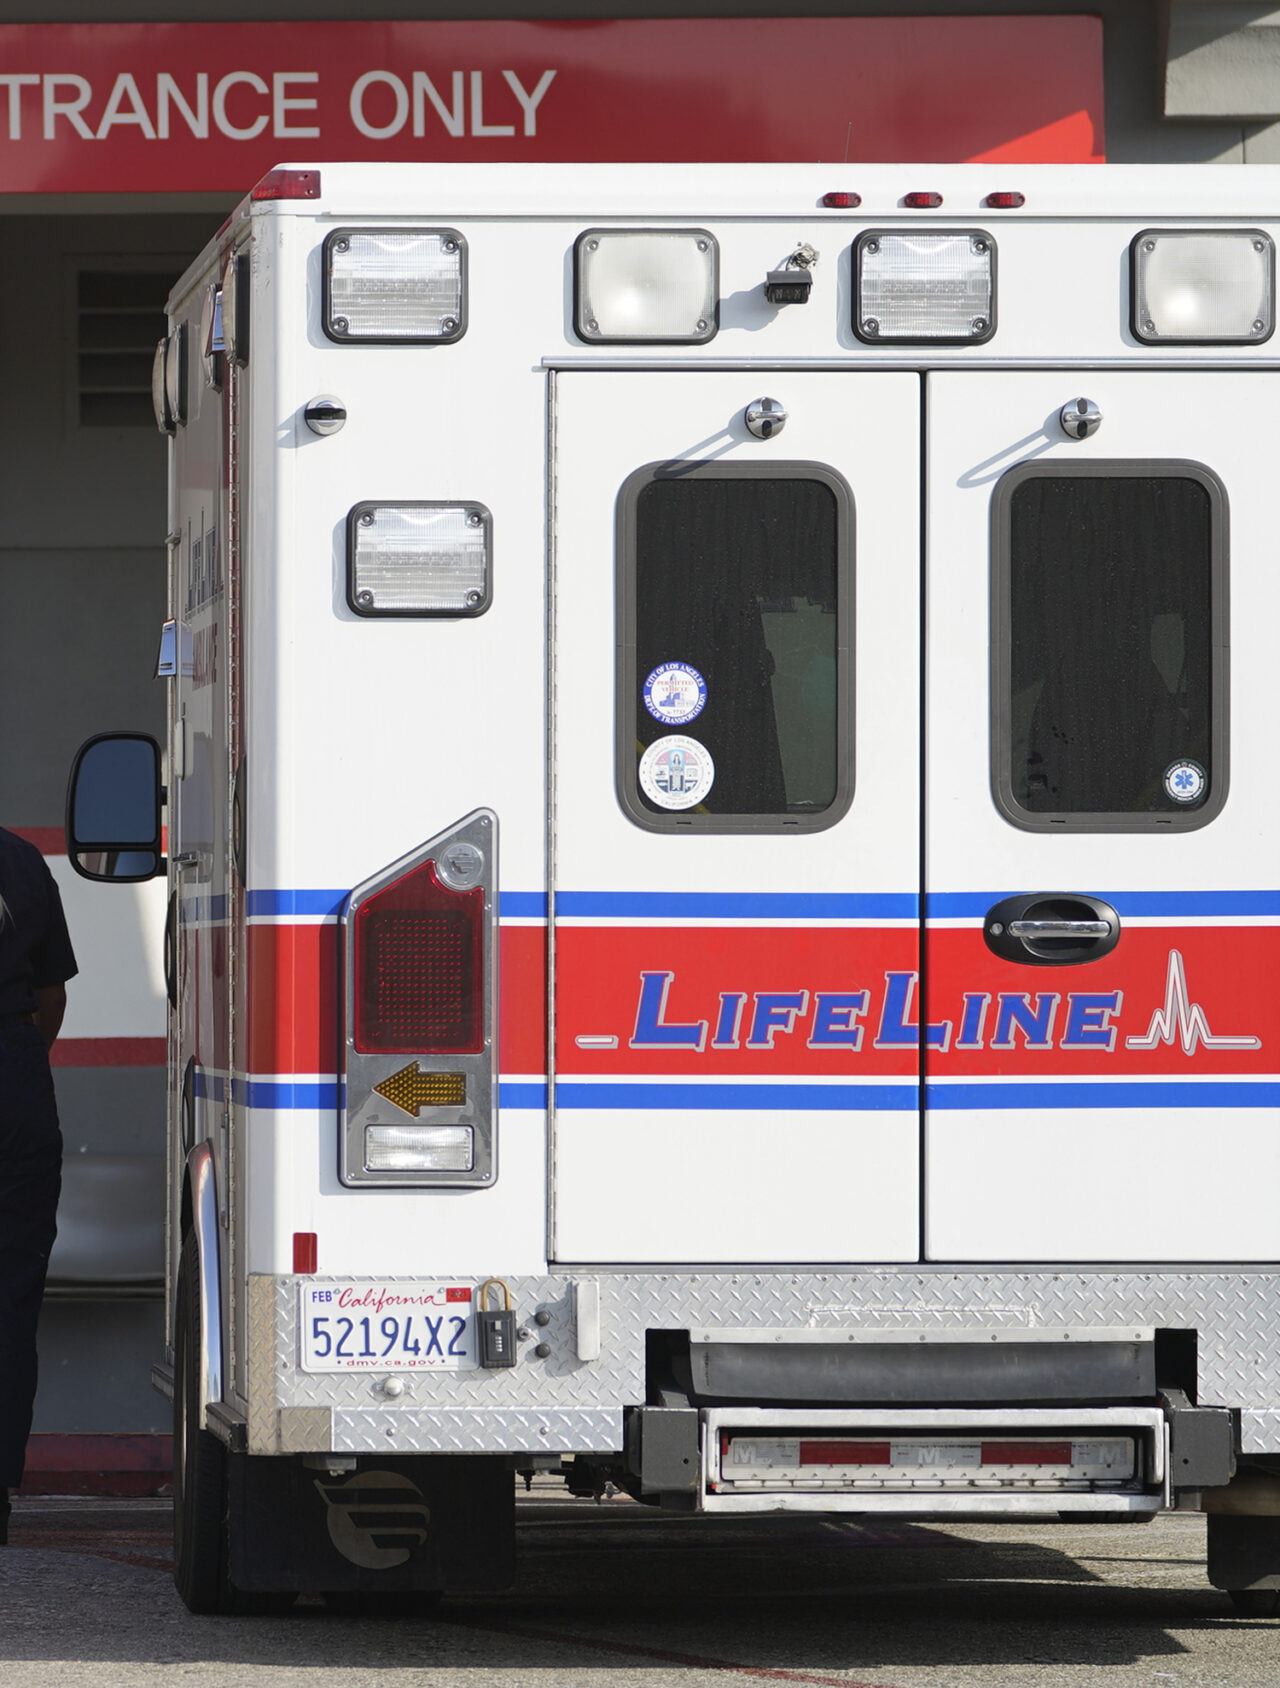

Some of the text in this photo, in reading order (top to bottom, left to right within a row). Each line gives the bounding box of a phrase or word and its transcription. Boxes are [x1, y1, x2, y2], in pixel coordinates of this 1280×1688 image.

[350, 70, 556, 138] ONLY
[646, 673, 658, 688] CITY
[665, 663, 679, 671] LOS
[680, 664, 704, 688] ANGELES
[312, 1290, 333, 1303] FEB
[338, 1287, 447, 1314] California
[312, 1315, 468, 1358] 52194X2
[346, 1359, 437, 1367] dmv.ca.gov
